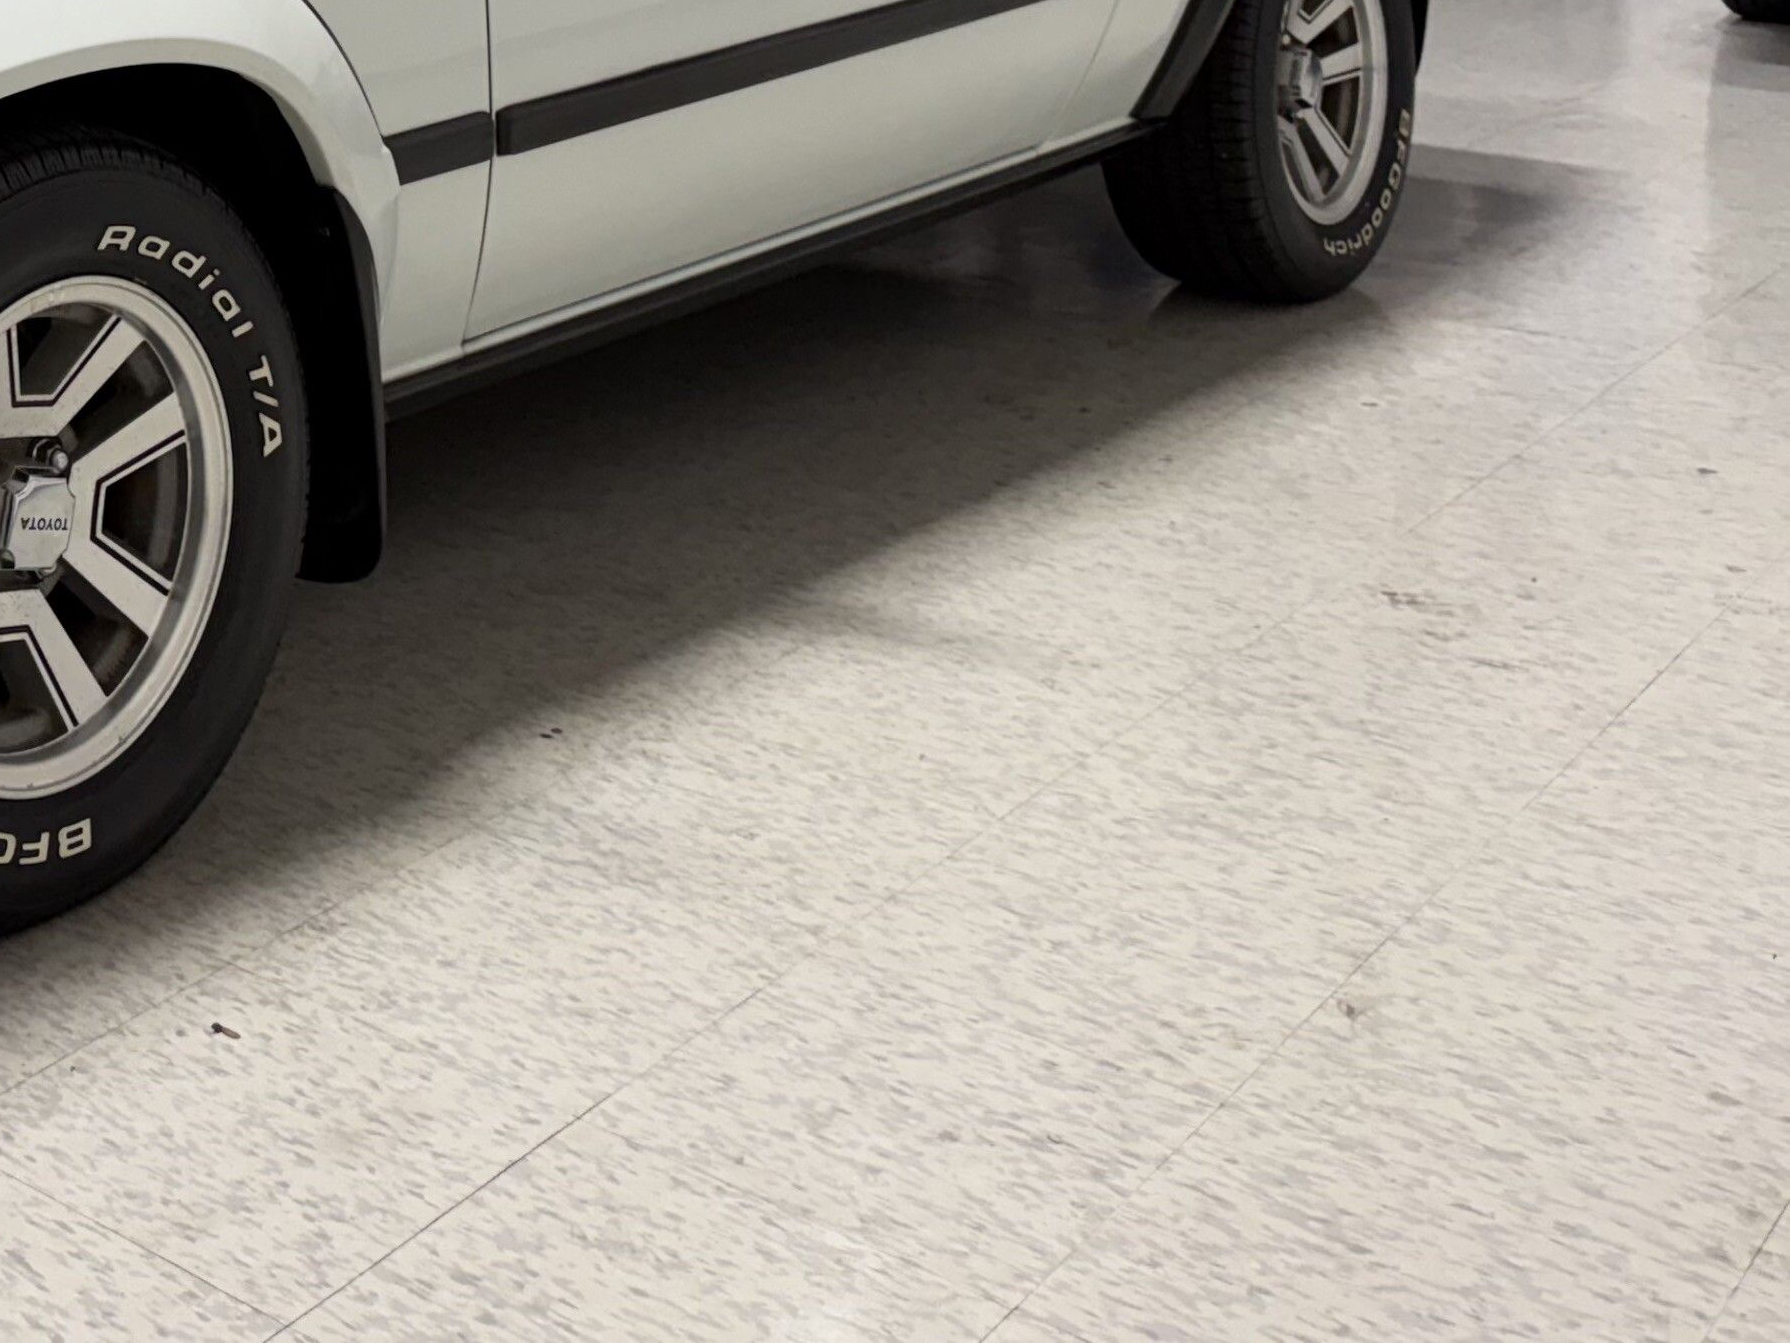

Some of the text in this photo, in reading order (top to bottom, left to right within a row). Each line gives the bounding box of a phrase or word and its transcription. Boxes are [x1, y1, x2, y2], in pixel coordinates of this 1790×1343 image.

[97, 225, 284, 458] Radial T/A
[20, 517, 68, 531] TOYOTA
